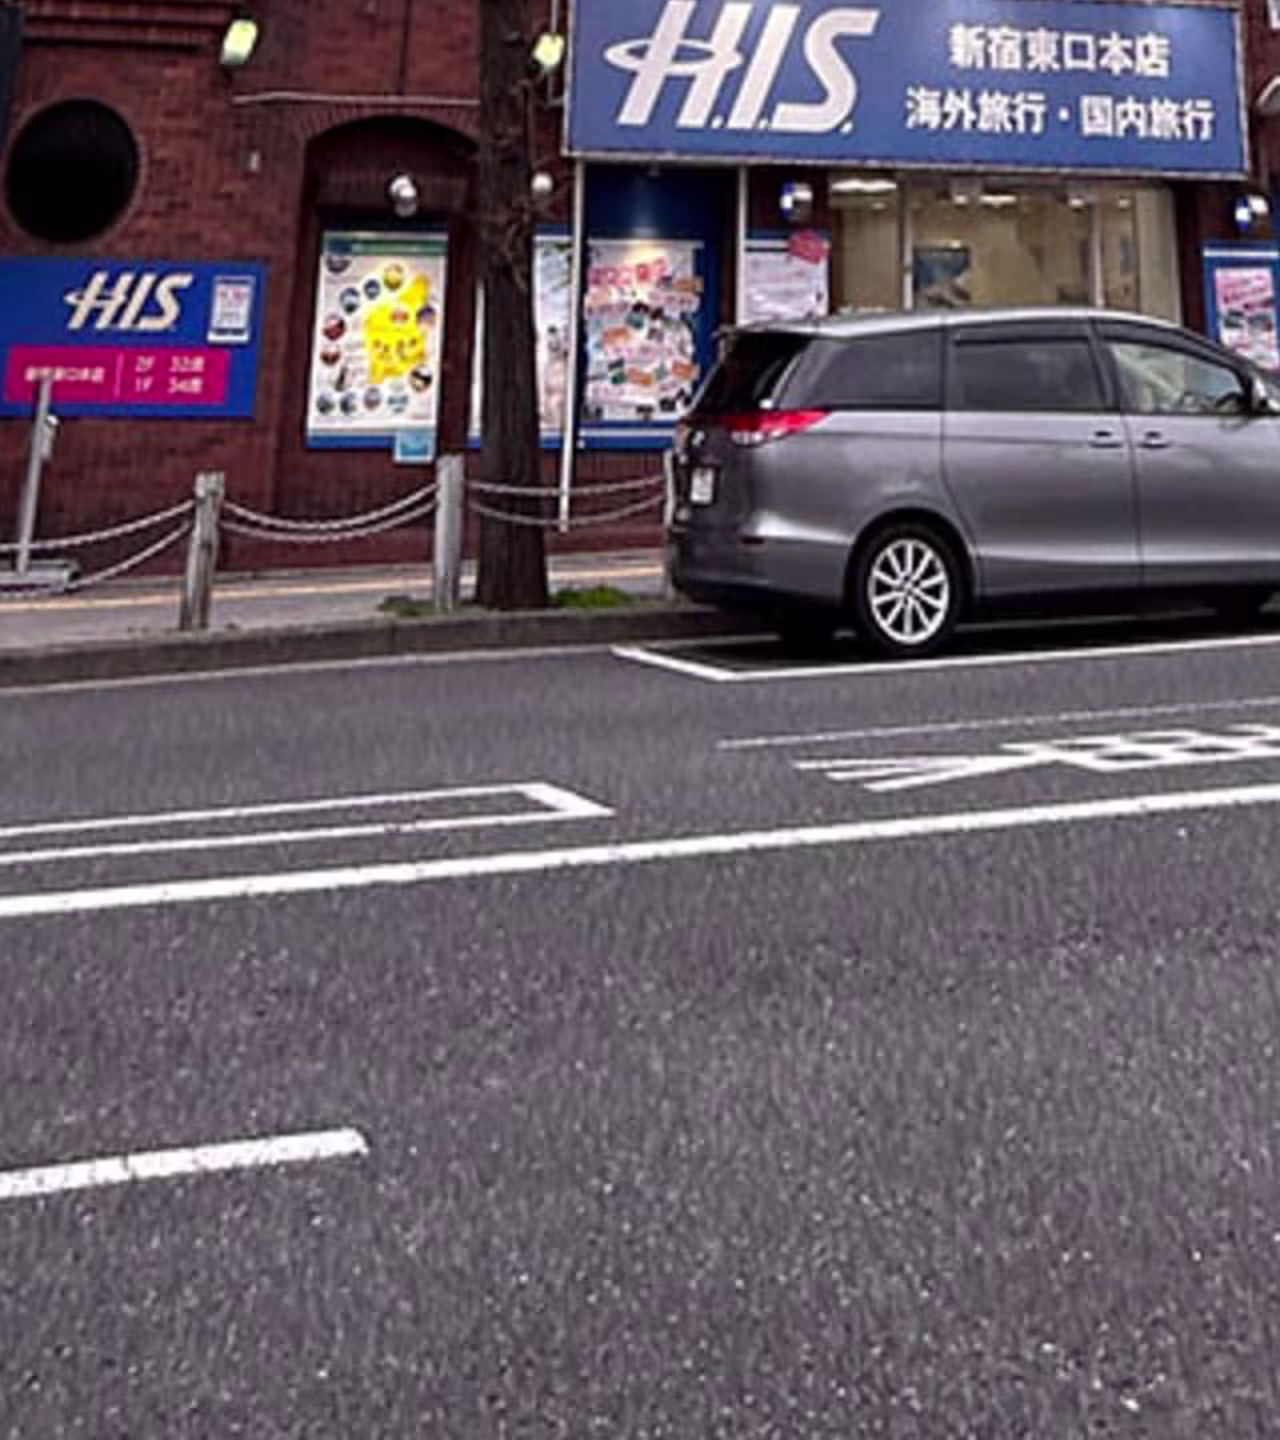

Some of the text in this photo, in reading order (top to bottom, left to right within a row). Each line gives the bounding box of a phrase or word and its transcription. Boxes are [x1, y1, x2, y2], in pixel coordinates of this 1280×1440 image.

[948, 23, 1171, 78] 新宿東口本店
[905, 85, 1216, 141] 海外旅行・国内旅行
